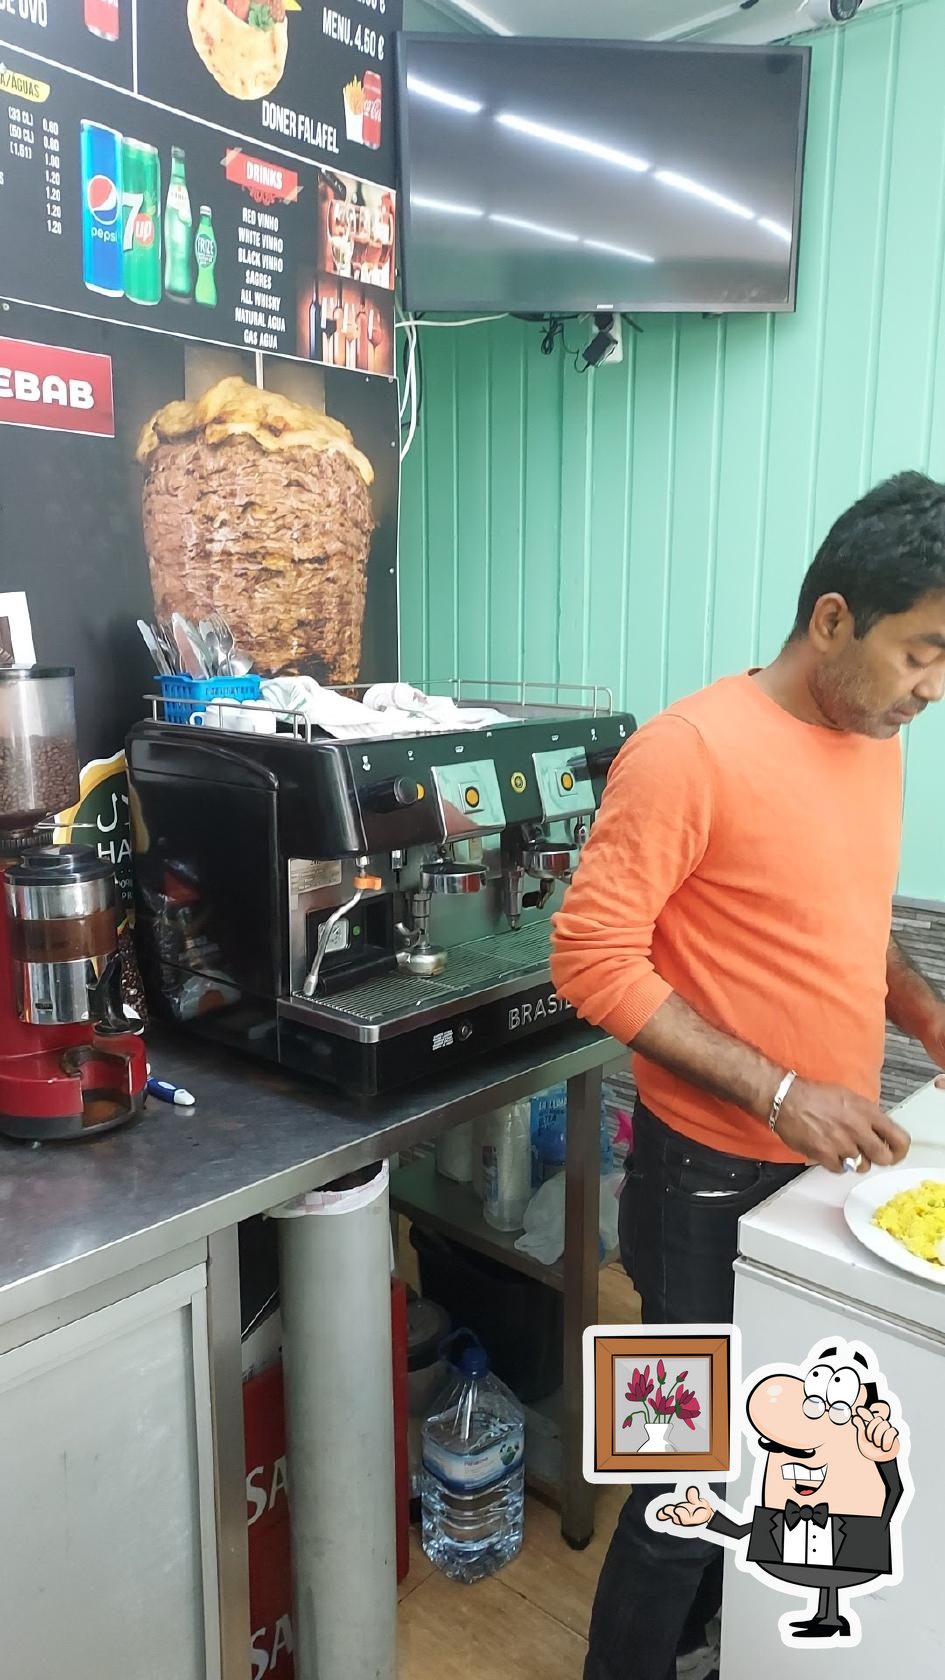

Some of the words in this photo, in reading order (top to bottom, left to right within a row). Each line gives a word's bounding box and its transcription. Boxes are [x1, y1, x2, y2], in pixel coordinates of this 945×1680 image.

[262, 99, 297, 137] DONER
[297, 114, 339, 154] FALAFEL
[45, 152, 60, 169] 1.00
[45, 169, 60, 185] 1.20
[247, 160, 283, 190] DRINKS
[45, 186, 61, 202] 1.20
[46, 202, 62, 218] 1.20
[242, 207, 257, 226] RED
[257, 212, 279, 233] VINHO
[47, 219, 62, 235] 1.20
[238, 226, 261, 248] WHITE
[261, 233, 284, 254] VINHO
[237, 247, 261, 268] BLACK
[261, 253, 284, 273] VINHO
[245, 269, 272, 290] SAGRES
[240, 288, 254, 305] ALL
[254, 291, 282, 312] WHISKY
[234, 306, 267, 328] NATURAL
[267, 314, 286, 333] AGUA
[243, 328, 258, 346] GAS
[259, 332, 278, 350] AGUA
[0, 366, 95, 410] EBAB
